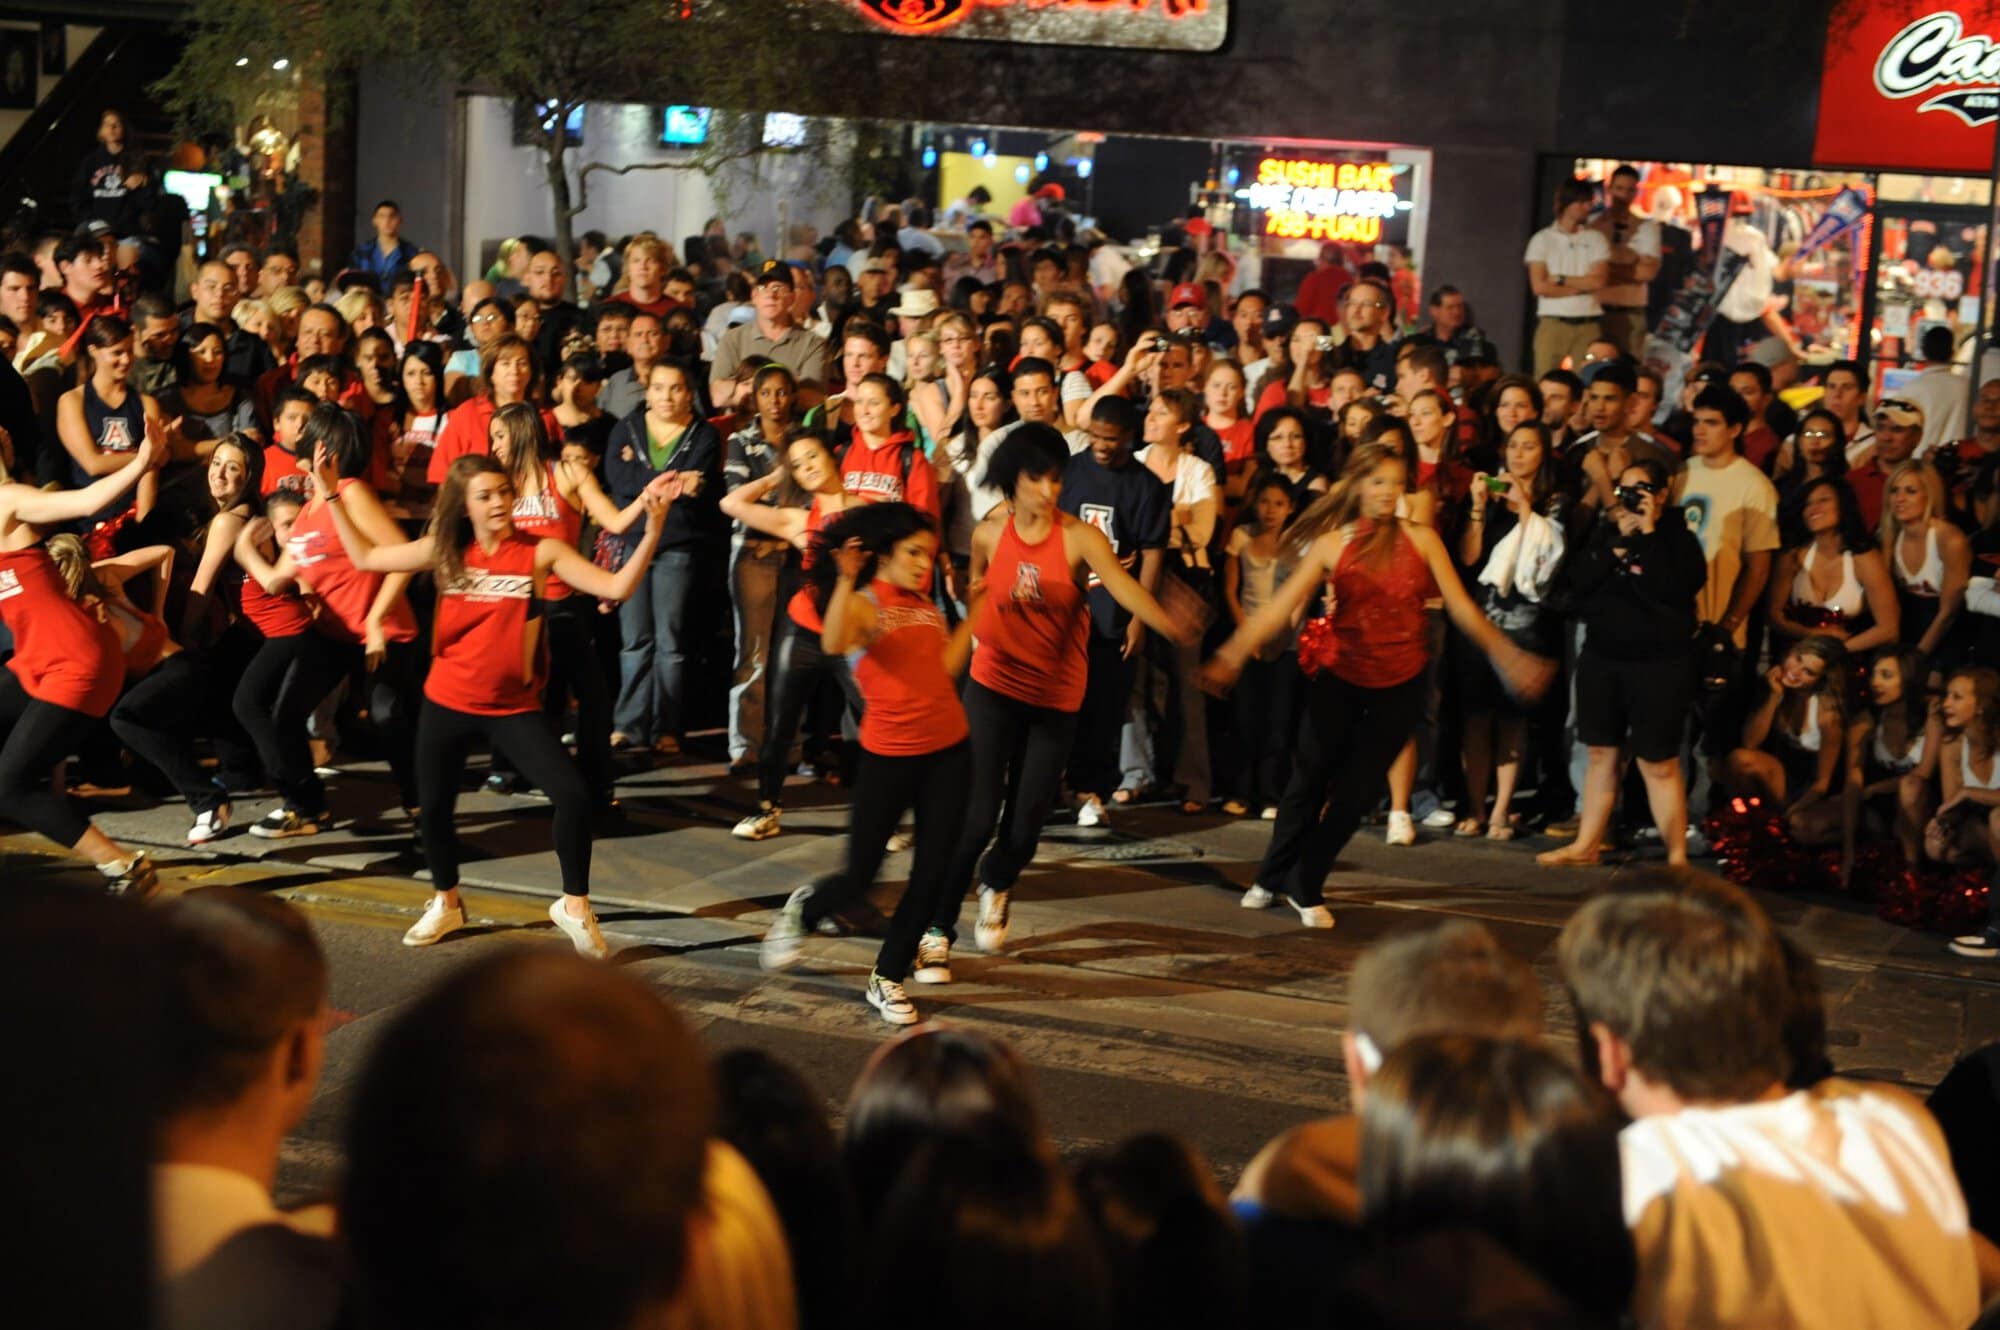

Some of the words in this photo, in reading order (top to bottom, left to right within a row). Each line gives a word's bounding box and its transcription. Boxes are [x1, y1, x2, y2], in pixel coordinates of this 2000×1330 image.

[1257, 158, 1336, 188] SUSHI
[1337, 163, 1394, 193] BAR
[98, 416, 134, 450] A
